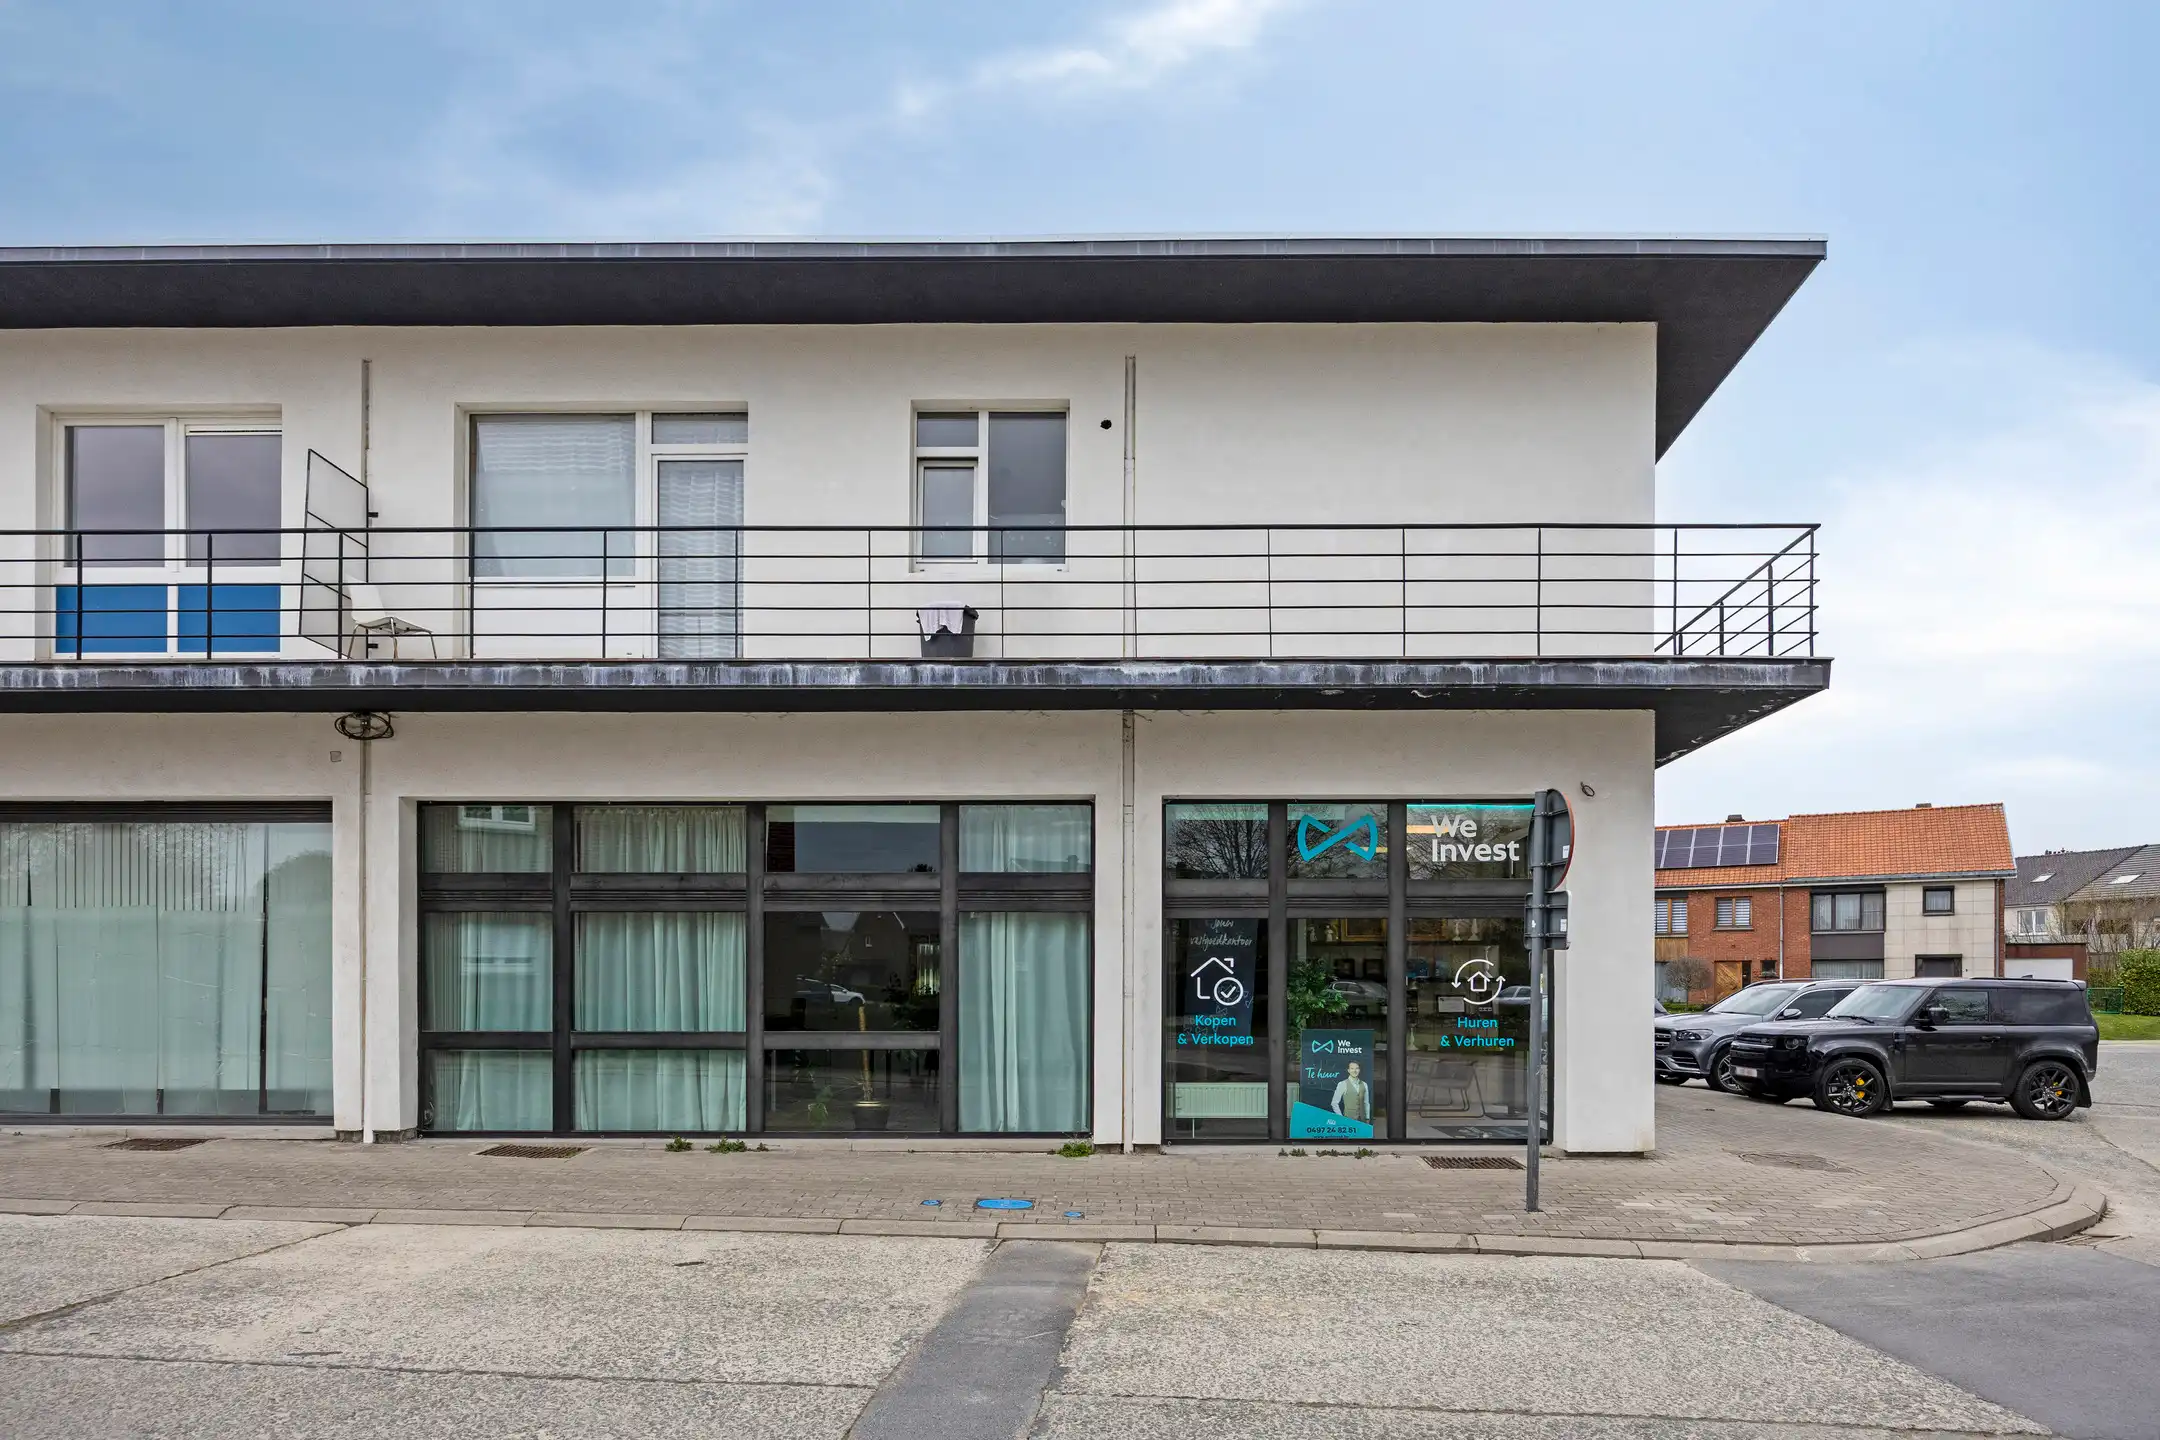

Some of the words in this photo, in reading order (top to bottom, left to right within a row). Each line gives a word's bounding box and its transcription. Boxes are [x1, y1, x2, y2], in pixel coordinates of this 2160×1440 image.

[1430, 815, 1477, 838] We
[1431, 839, 1520, 862] Invest
[1195, 1014, 1237, 1029] Kopen
[1457, 1016, 1498, 1029] Huren
[1177, 1033, 1188, 1045] &
[1191, 1033, 1254, 1047] Verkopen
[1337, 1039, 1351, 1047] We
[1440, 1035, 1451, 1047] &
[1454, 1035, 1515, 1047] Verhuren
[1337, 1046, 1362, 1054] Invest
[1305, 1067, 1316, 1079] Te
[1317, 1067, 1340, 1080] huur
[1306, 1126, 1326, 1134] 0497
[1326, 1126, 1337, 1134] 24
